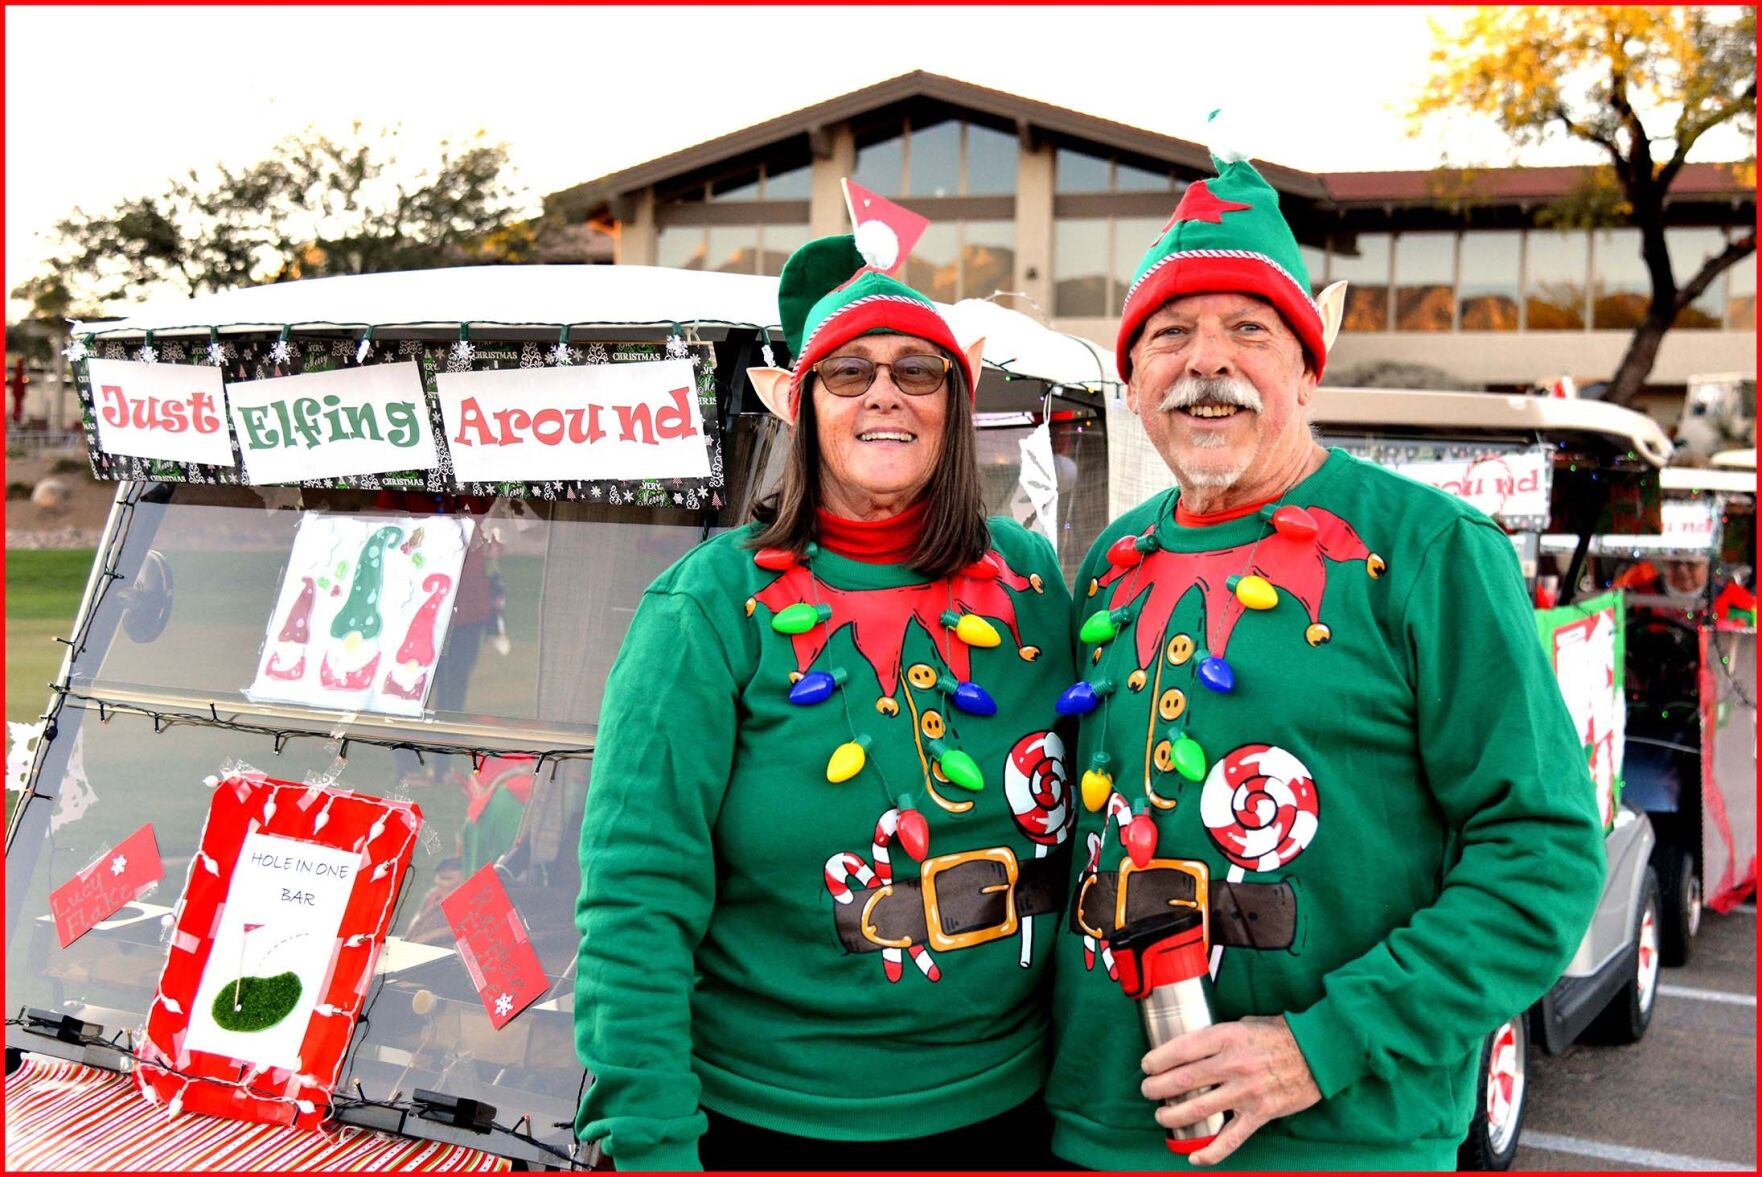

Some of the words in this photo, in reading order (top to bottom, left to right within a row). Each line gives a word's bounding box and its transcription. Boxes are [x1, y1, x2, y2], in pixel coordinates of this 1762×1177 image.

[612, 352, 661, 361] CHRISTMAS
[101, 384, 220, 434] Just
[237, 394, 421, 450] Elfing
[454, 386, 698, 447] Around
[382, 478, 425, 487] CHRISTMAS
[251, 852, 294, 871] HOLE
[296, 859, 314, 873] IN
[315, 862, 350, 879] ONE
[52, 871, 105, 915] Lucy
[281, 887, 316, 906] BAR
